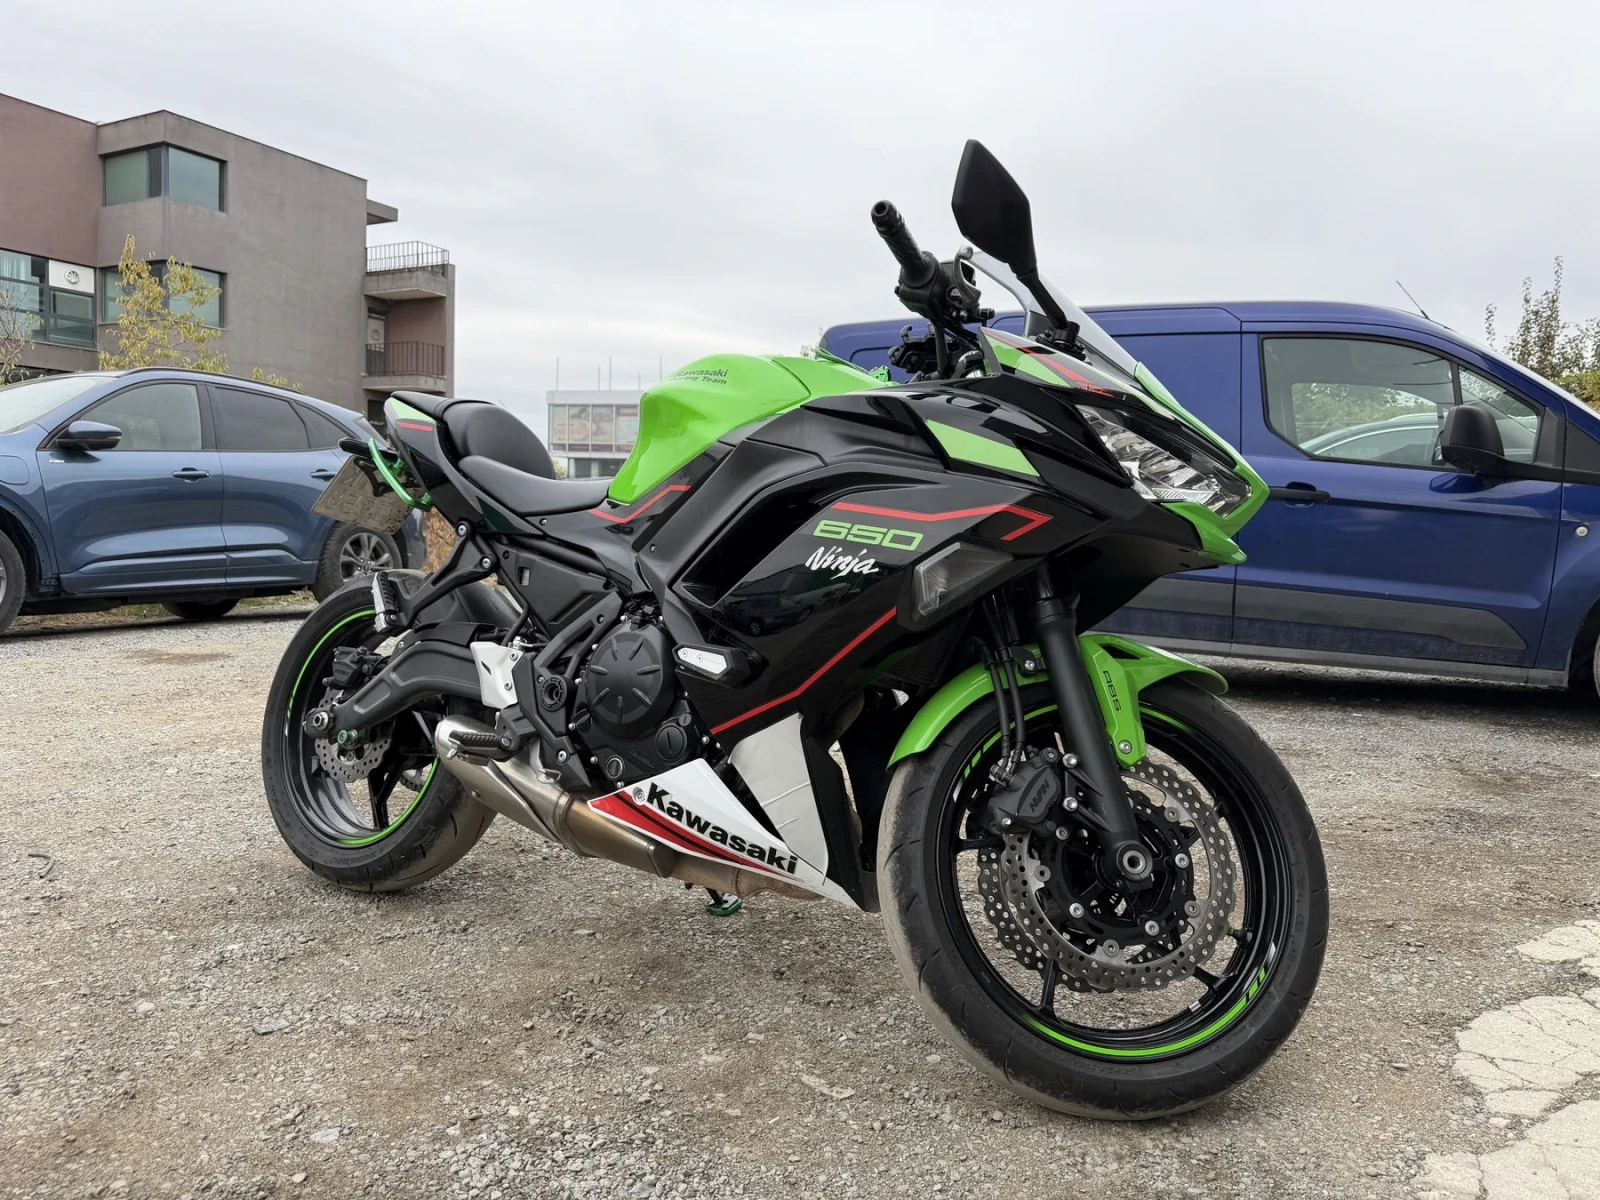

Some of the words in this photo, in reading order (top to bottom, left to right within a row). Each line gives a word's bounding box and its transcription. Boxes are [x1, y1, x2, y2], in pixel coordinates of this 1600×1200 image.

[702, 376, 727, 385] Team
[813, 520, 924, 551] 650
[804, 546, 879, 580] Ninja
[1103, 670, 1122, 712] ABS
[647, 782, 798, 875] Kawasaki
